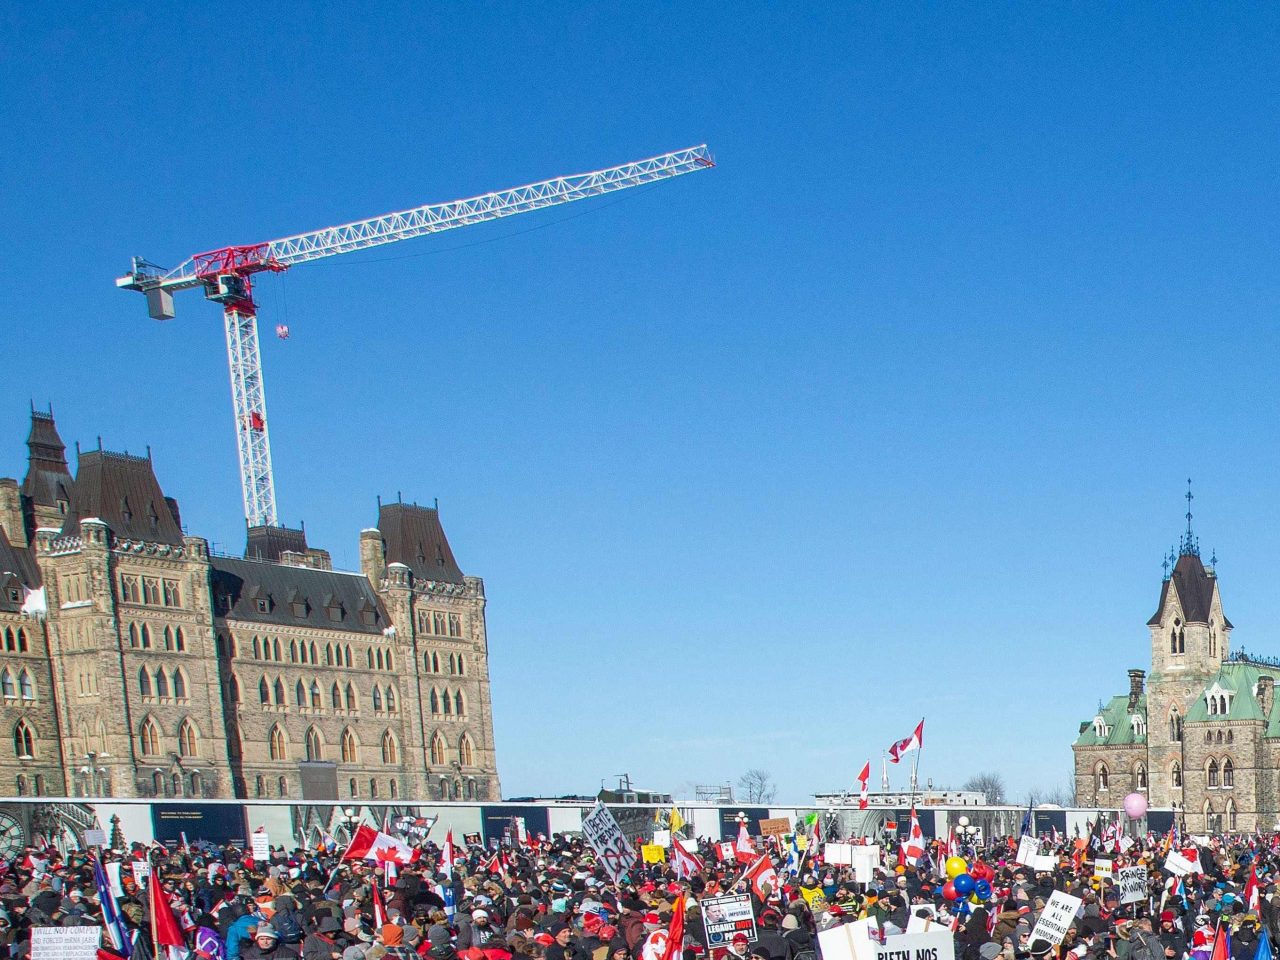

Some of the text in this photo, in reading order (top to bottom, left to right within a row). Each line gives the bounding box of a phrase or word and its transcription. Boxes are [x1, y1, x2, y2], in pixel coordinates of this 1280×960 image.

[1050, 900, 1073, 914] WE ARE
[1051, 910, 1062, 921] ALL
[707, 923, 736, 933] LEGAULT
[1038, 919, 1067, 935] ESSENTIALS
